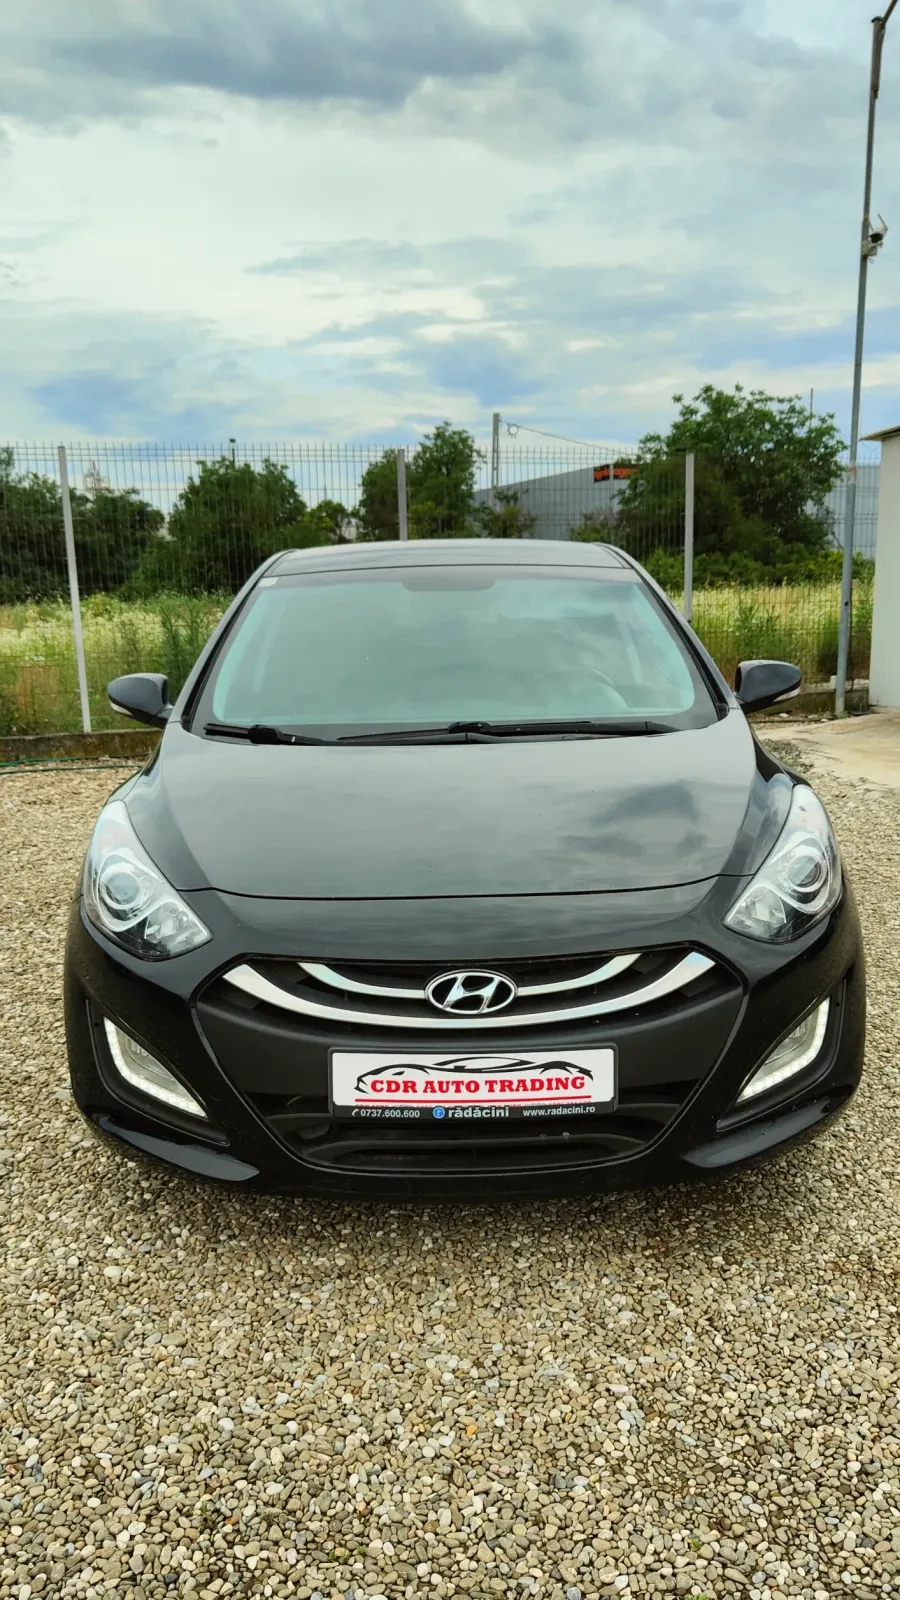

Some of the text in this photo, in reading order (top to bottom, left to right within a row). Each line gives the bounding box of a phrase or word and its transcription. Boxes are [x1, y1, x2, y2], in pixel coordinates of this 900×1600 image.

[370, 1076, 585, 1093] CDR AUTO TRADING
[360, 1109, 420, 1118] 0737.600.600
[448, 1106, 509, 1118] rădăcini
[522, 1106, 596, 1117] www.radacini.ro
